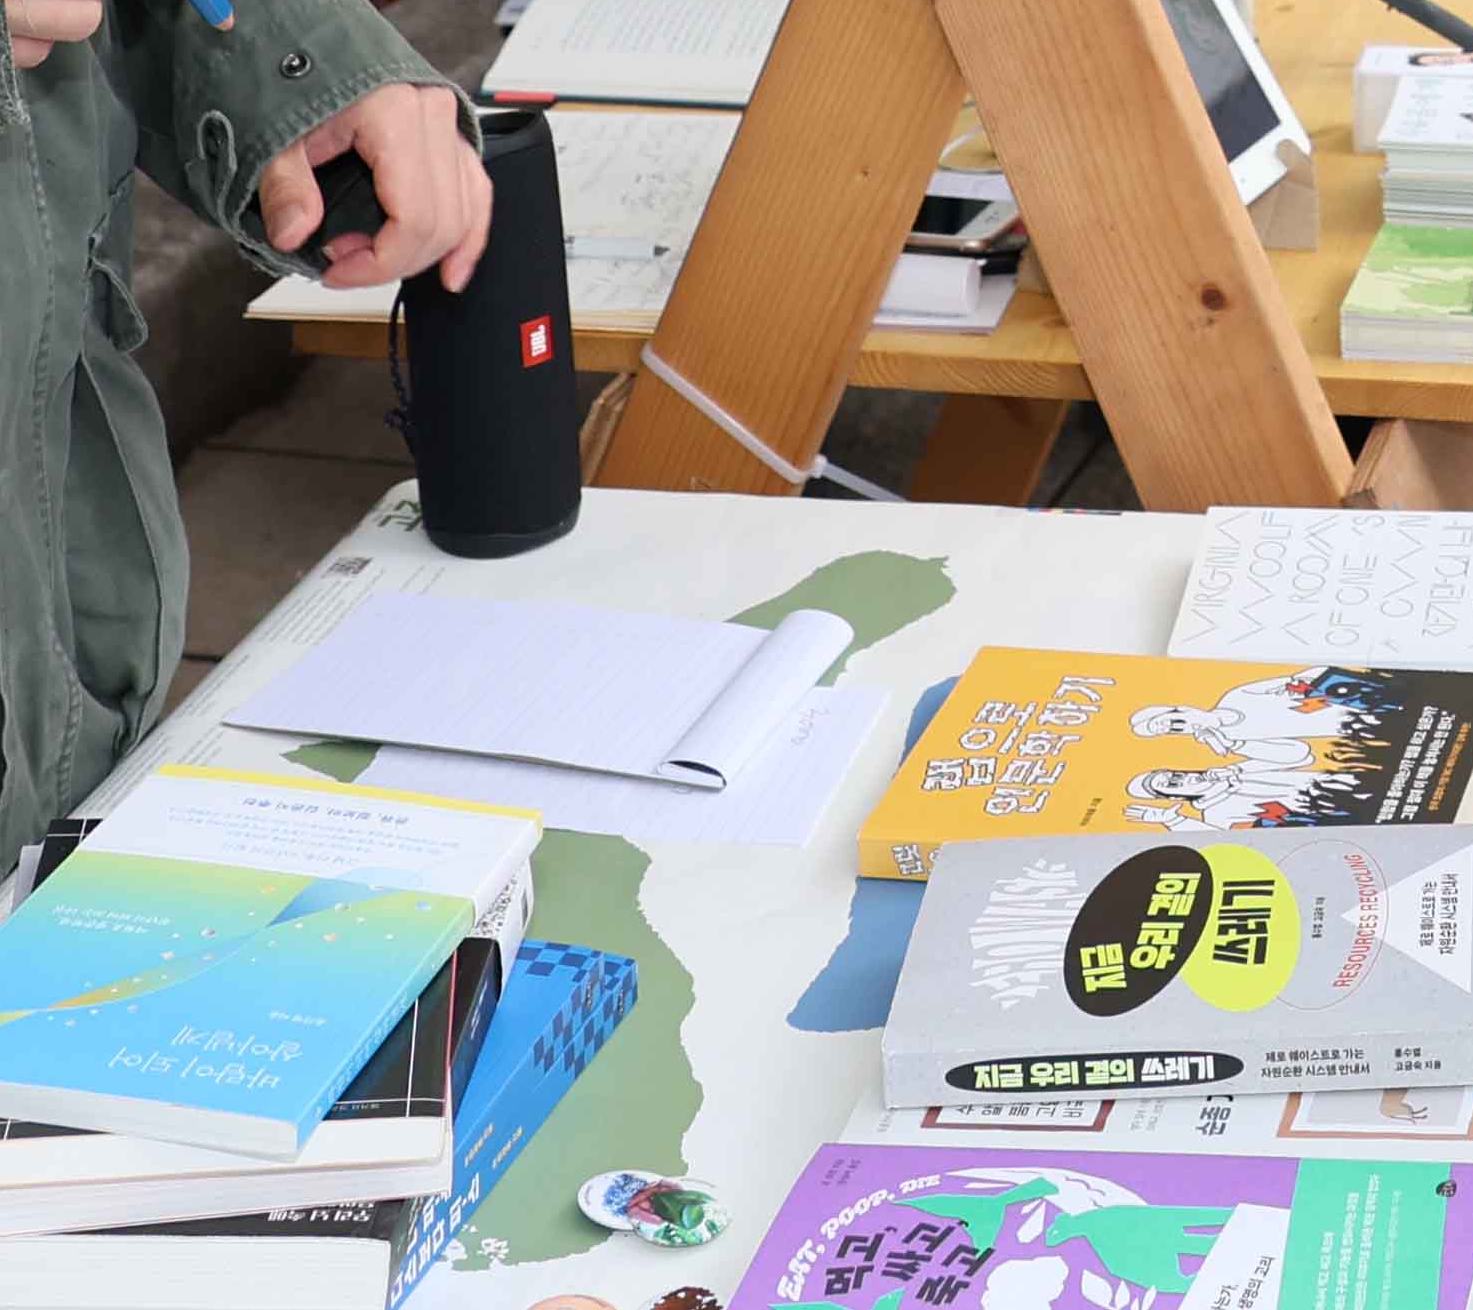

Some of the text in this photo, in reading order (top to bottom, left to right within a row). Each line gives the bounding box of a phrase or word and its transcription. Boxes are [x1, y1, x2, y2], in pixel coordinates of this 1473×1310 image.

[530, 325, 548, 357] JBL
[1184, 510, 1252, 643] VIRGINIA
[1229, 509, 1293, 645] WOOLF
[1289, 513, 1339, 606] ROOM
[1379, 514, 1433, 619] OWN
[1325, 609, 1359, 647] OF
[921, 700, 1039, 791] 랩으로
[1128, 871, 1203, 970] 우리 곁의
[1212, 879, 1276, 966] 쓰레기
[1332, 853, 1379, 988] RESOURCES RECYCLING
[1418, 881, 1439, 947] 제로 웨이스트로 가는
[1439, 872, 1461, 956] 자원순환 시스템 안내서
[1079, 942, 1128, 994] 지금
[107, 1046, 281, 1090] 바람이 되어
[170, 1024, 304, 1063] 살아낼게
[973, 1054, 1216, 1089] 지금 우리 곁의 쓰레기
[1261, 1062, 1371, 1080] 자원순환 시스템 안내서
[1265, 1047, 1365, 1063] 제로 웨이스트로 가는
[1393, 1059, 1442, 1073] 고금숙 지음
[332, 1209, 373, 1223] 우리
[777, 1174, 942, 1302] EAT, POOP, DIE
[823, 1226, 898, 1297] 먹고,
[880, 1218, 969, 1282] 싸고,
[914, 1243, 996, 1306] 죽고
